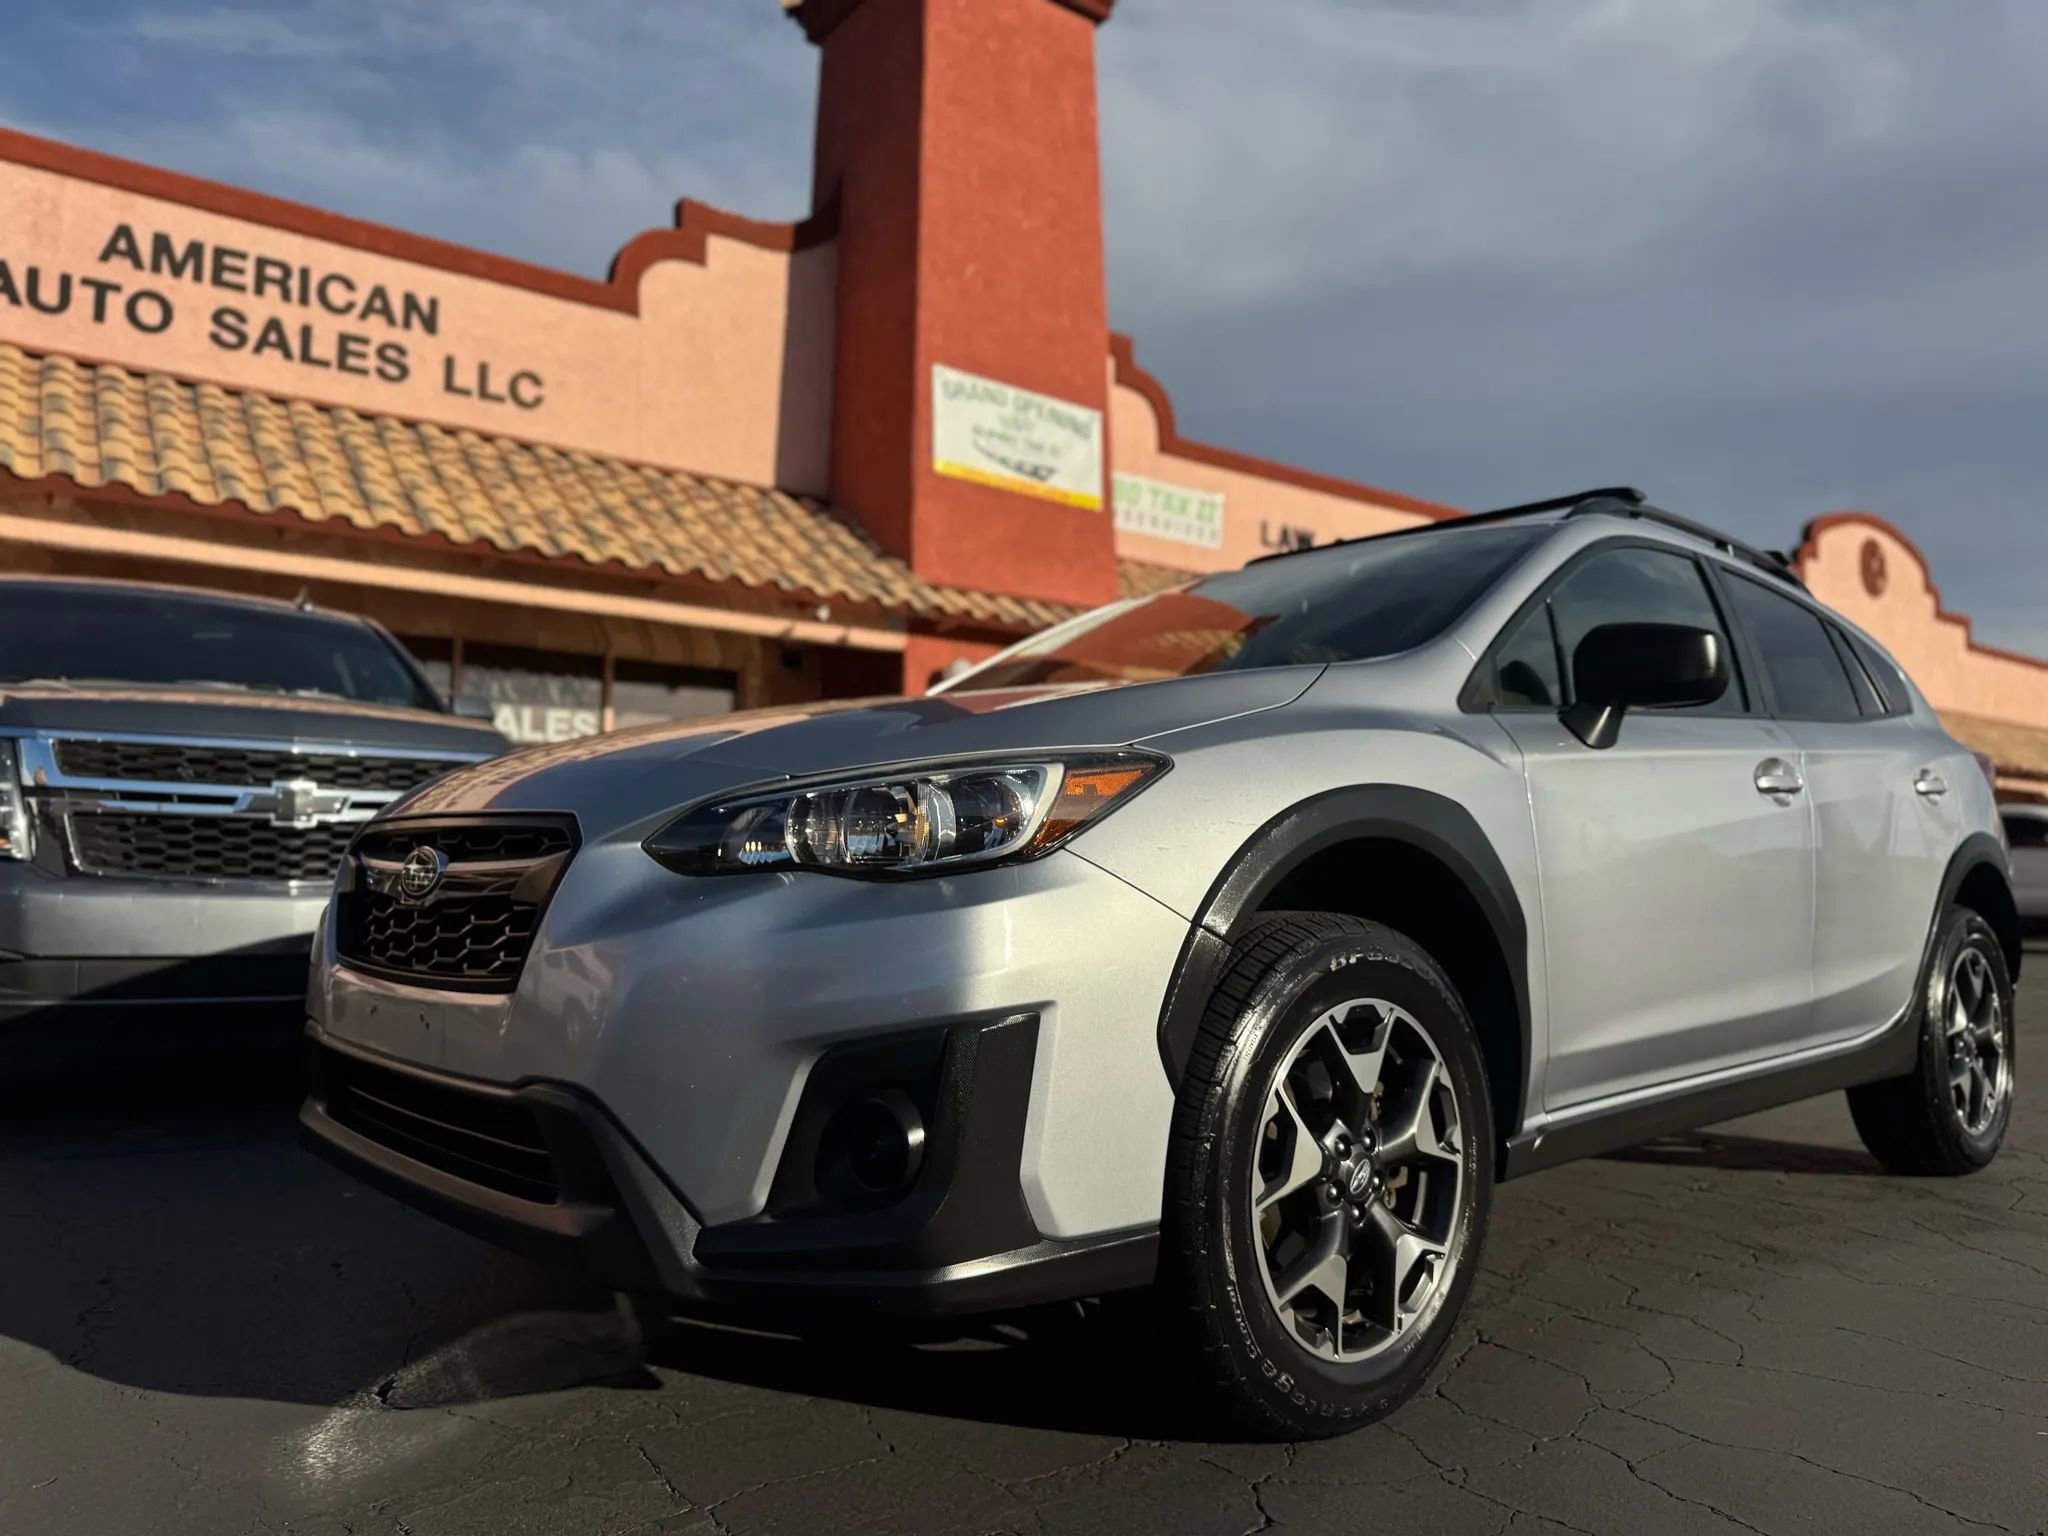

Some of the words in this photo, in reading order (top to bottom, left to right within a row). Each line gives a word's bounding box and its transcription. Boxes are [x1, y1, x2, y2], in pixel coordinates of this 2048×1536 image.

[97, 223, 440, 336] AMERICAN
[208, 306, 411, 384] SALES
[443, 354, 545, 411] LLC
[492, 704, 599, 743] ALES
